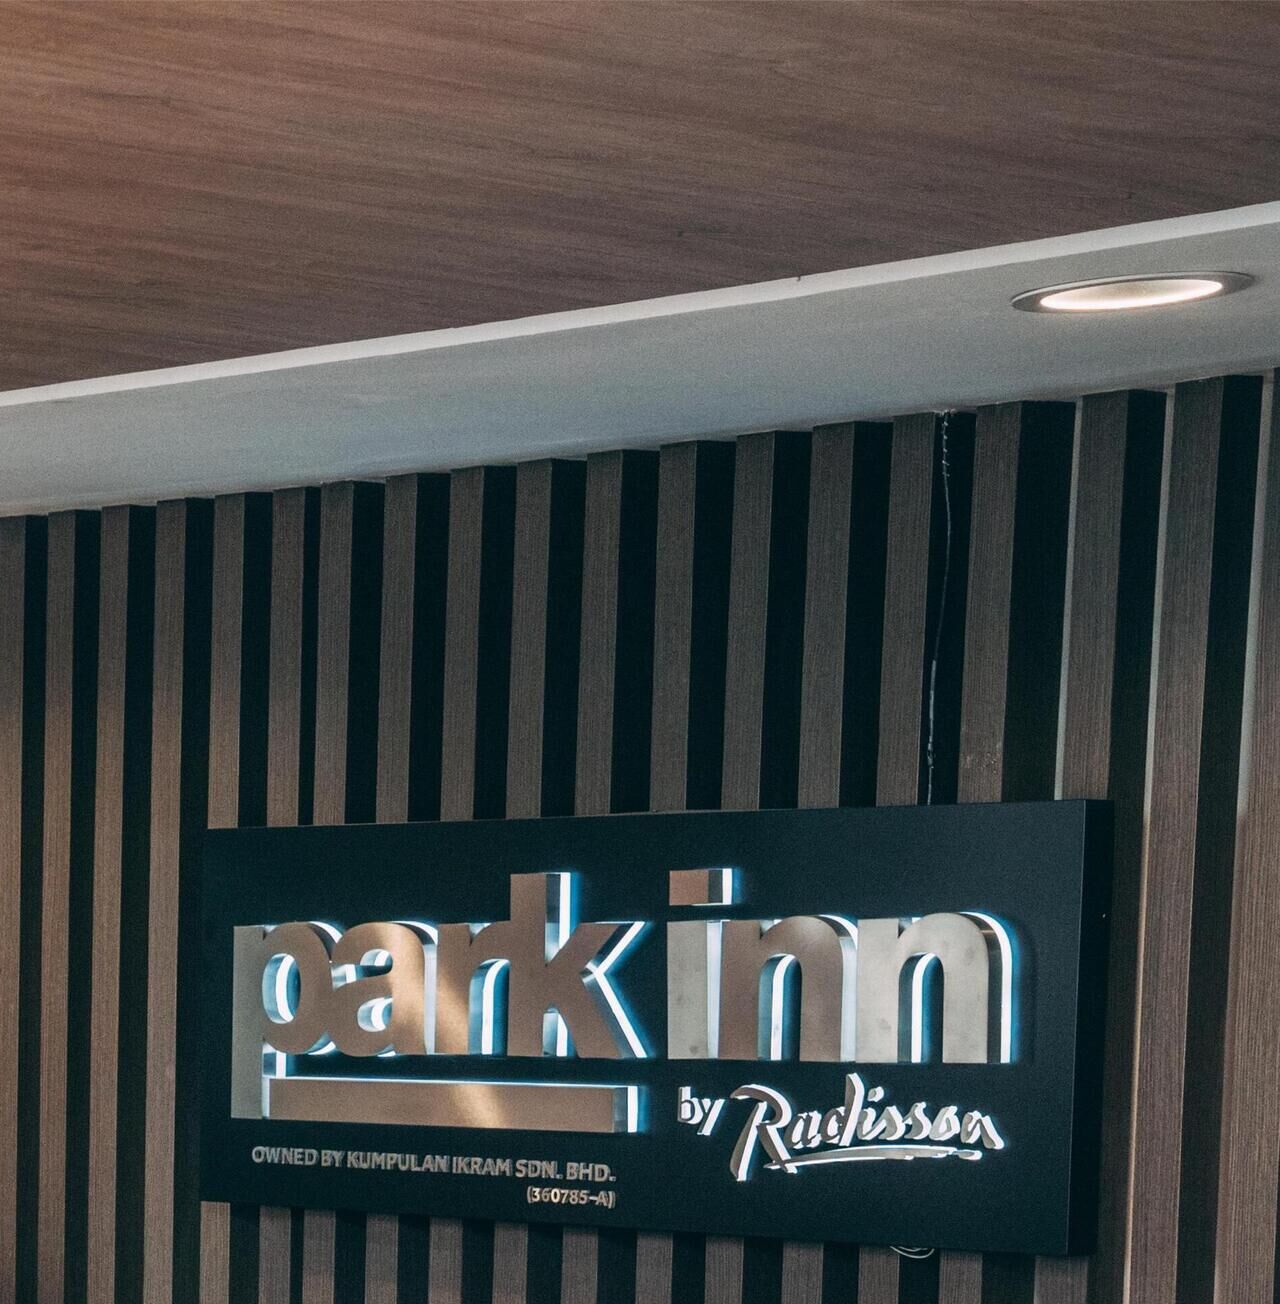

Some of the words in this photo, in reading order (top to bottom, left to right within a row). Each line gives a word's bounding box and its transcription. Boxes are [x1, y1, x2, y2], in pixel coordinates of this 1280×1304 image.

[230, 871, 648, 1119] park
[666, 867, 1013, 1064] inn
[677, 1086, 726, 1136] by
[729, 1072, 1005, 1182] Radisson
[251, 1146, 318, 1166] OWNED
[321, 1149, 344, 1167] BY
[346, 1151, 450, 1173] KUMPULAN
[452, 1156, 511, 1177] IKRAM
[515, 1159, 563, 1180] SDN.
[566, 1162, 617, 1182] BHD.
[526, 1187, 616, 1209] (360785-A)
